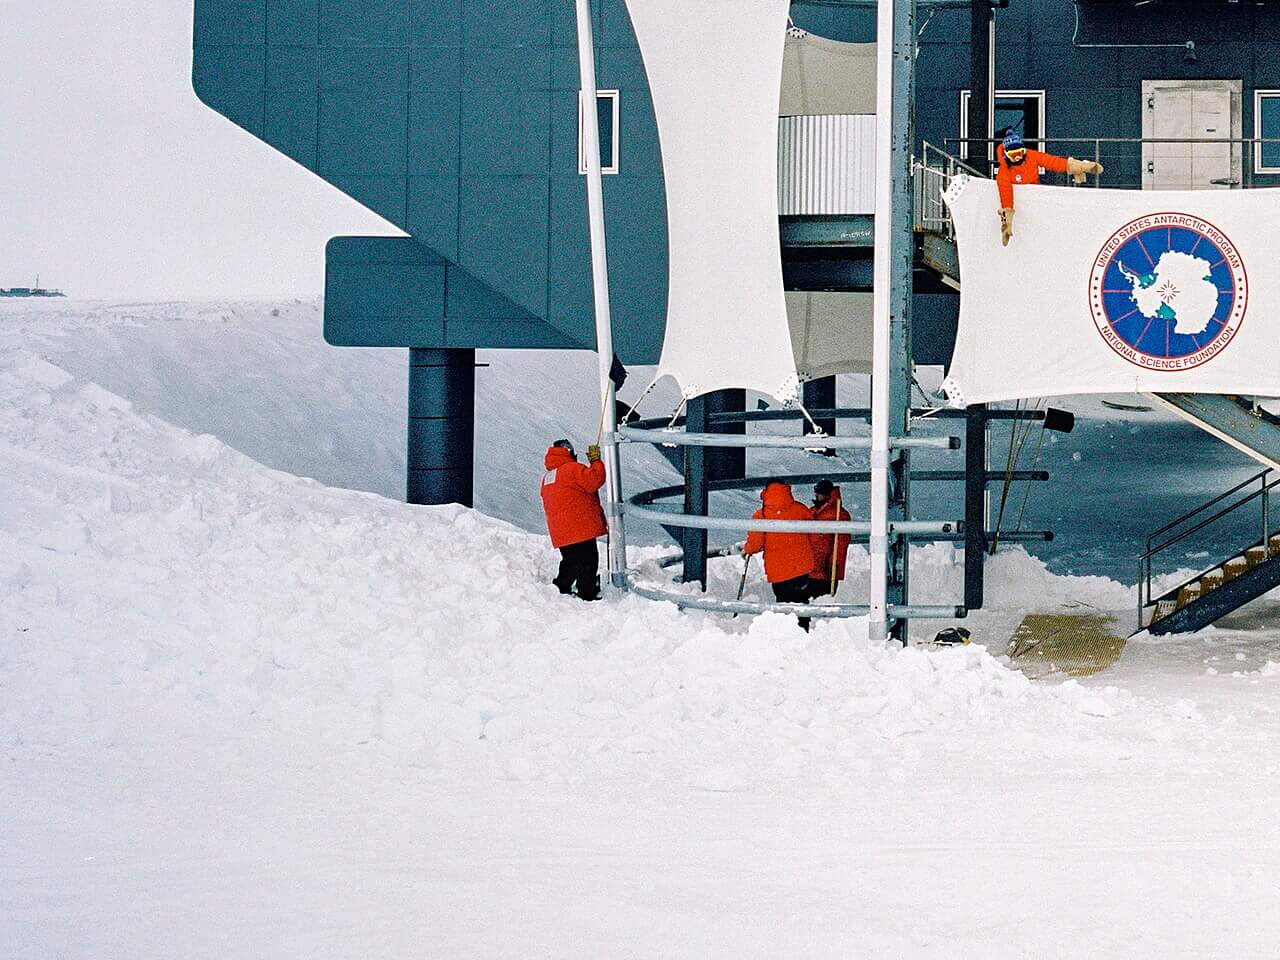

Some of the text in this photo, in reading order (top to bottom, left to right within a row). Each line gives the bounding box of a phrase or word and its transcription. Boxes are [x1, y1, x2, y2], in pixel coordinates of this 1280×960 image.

[1097, 215, 1240, 269] UNITED STATES ANTARCTIC PROGRAM
[1101, 325, 1235, 369] NATIONAL SCIENCE FOUNDATION
